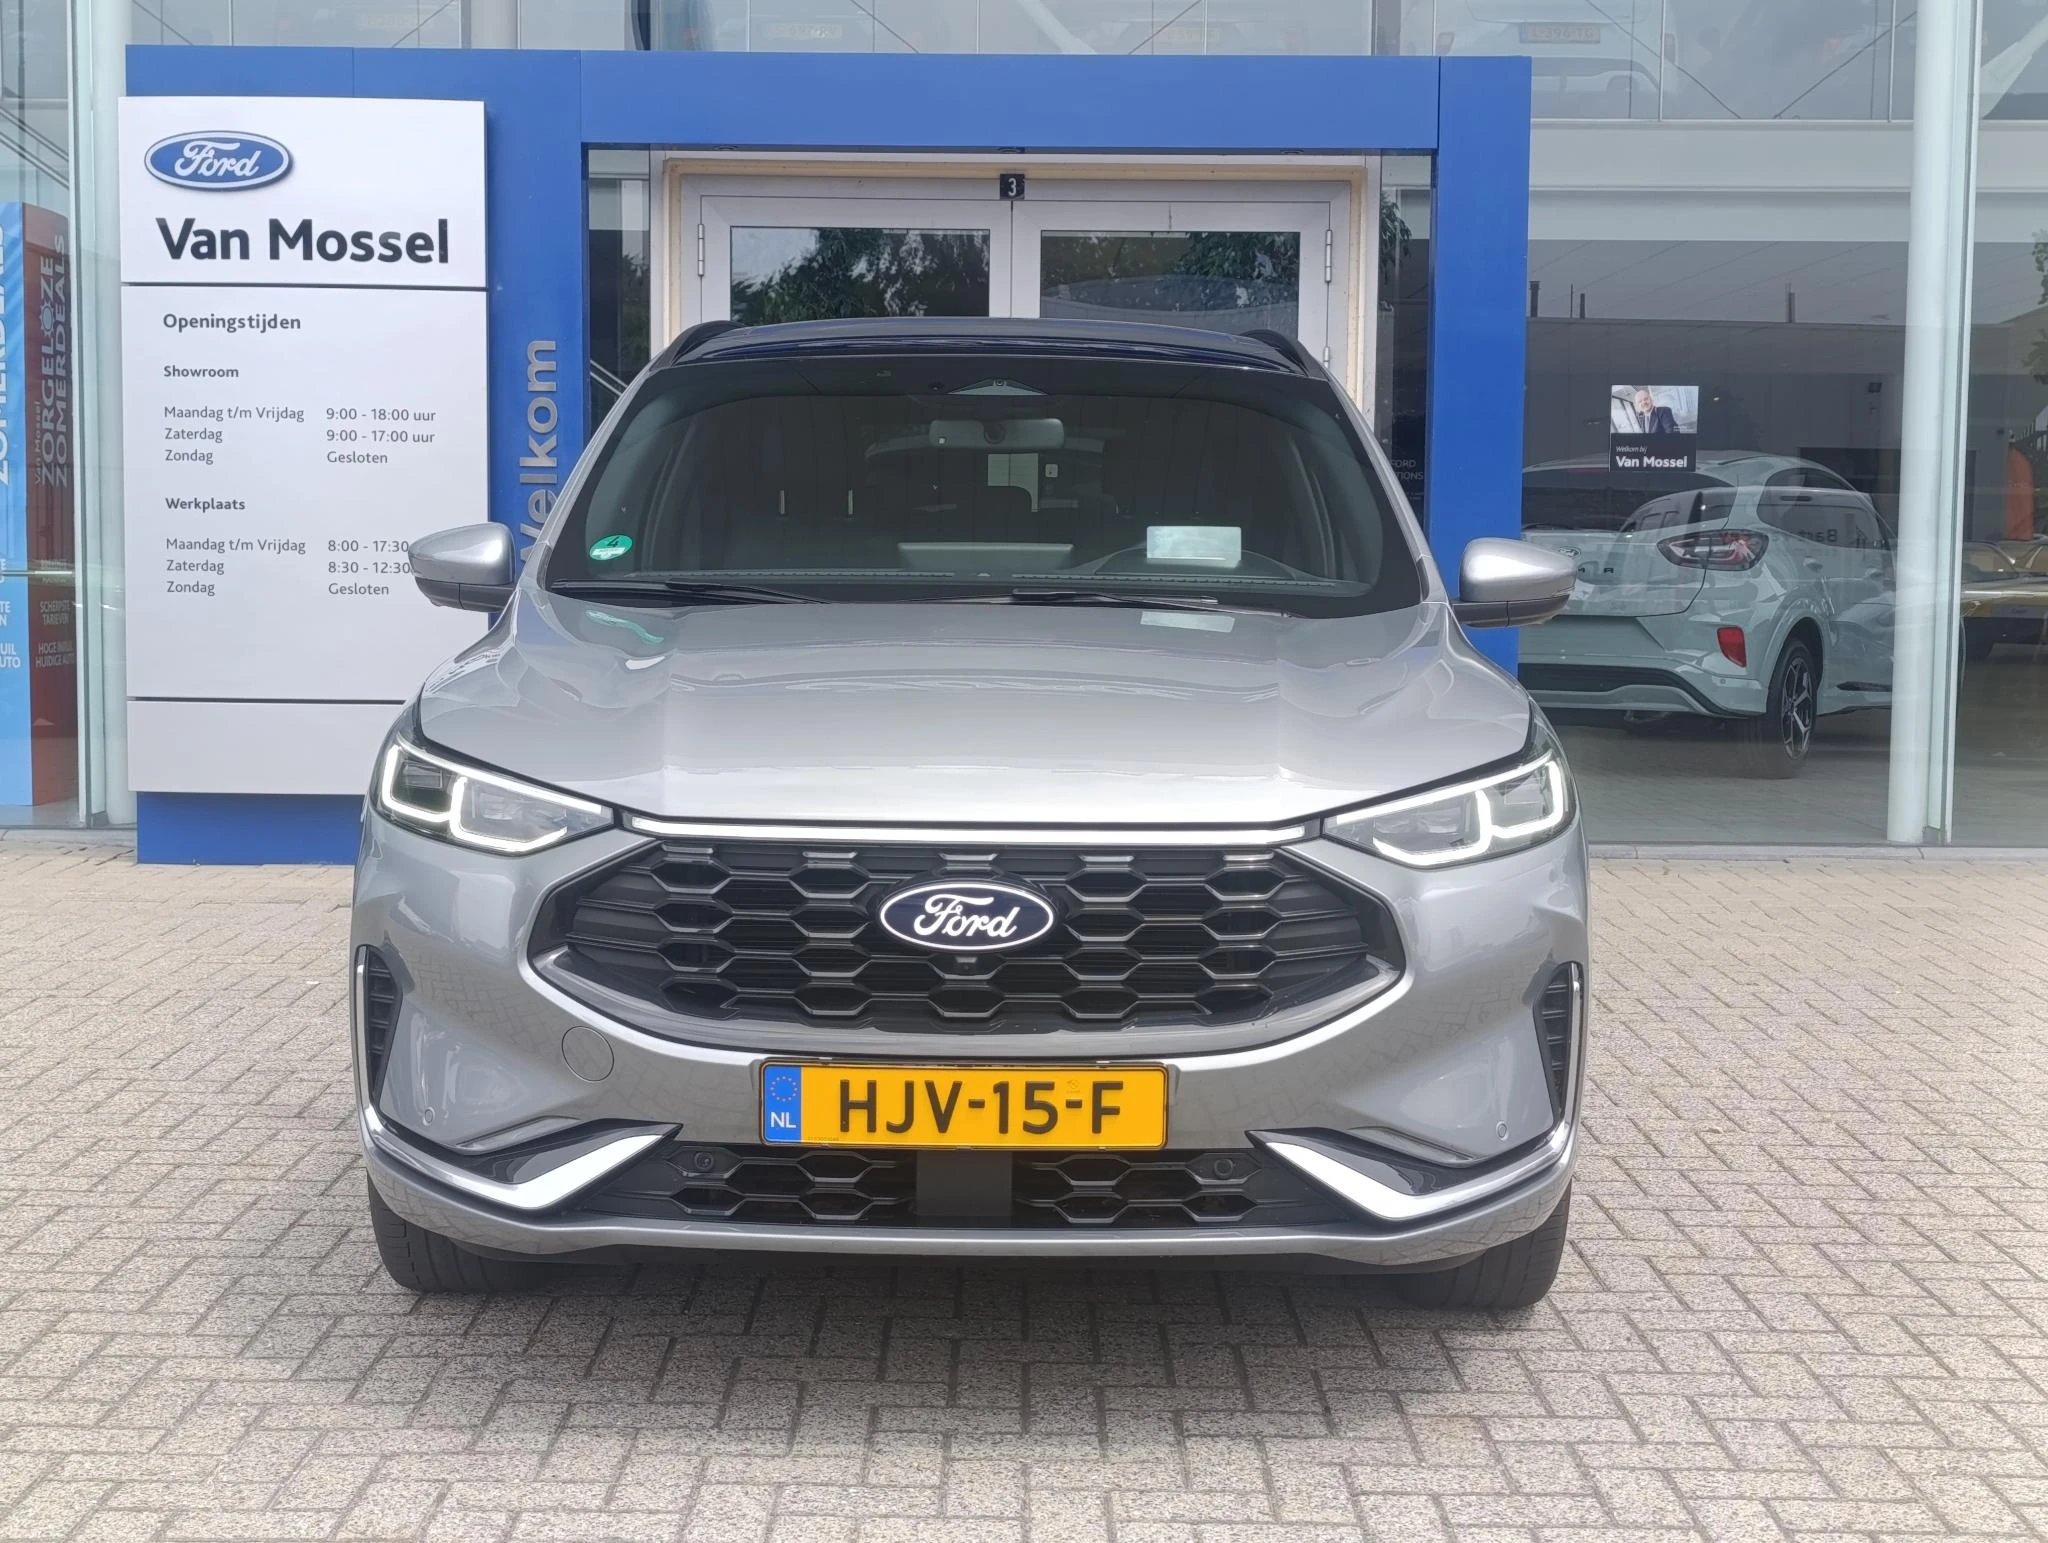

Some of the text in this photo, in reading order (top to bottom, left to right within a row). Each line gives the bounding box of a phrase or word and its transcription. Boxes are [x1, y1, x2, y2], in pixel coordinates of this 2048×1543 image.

[174, 140, 262, 177] Ford
[1008, 177, 1017, 196] 3
[155, 217, 449, 264] Van Mossel
[163, 313, 301, 333] Openingstijden
[54, 234, 68, 488] ZOMERDEALS
[163, 365, 240, 378] Showroom
[164, 406, 224, 422] Maandag
[227, 407, 252, 419] t/m
[255, 407, 305, 422] Vrijdag
[326, 408, 357, 420] 9:00
[371, 408, 409, 421] 18:00
[413, 410, 436, 421] uur
[164, 428, 223, 443] Zaterdag
[326, 430, 358, 442] 9:00
[371, 430, 409, 442] 17:00
[412, 432, 436, 443] uur
[164, 450, 388, 465] Zondag Gesloten
[1615, 455, 1688, 468] Van Mossel
[165, 497, 246, 513] Werkplaats
[165, 538, 226, 553] Maandag
[229, 539, 253, 551] t/m
[257, 539, 306, 555] Vrijdag
[328, 540, 359, 552] 8:00
[372, 540, 409, 552] 17:30
[166, 560, 224, 575] Zaterdag
[328, 561, 359, 574] 8:30
[373, 561, 411, 574] 12:30
[166, 581, 389, 596] Zondag Gesloten
[913, 893, 1021, 938] Ford
[838, 1078, 1125, 1136] HJV-15-F
[770, 1111, 797, 1130] NL
